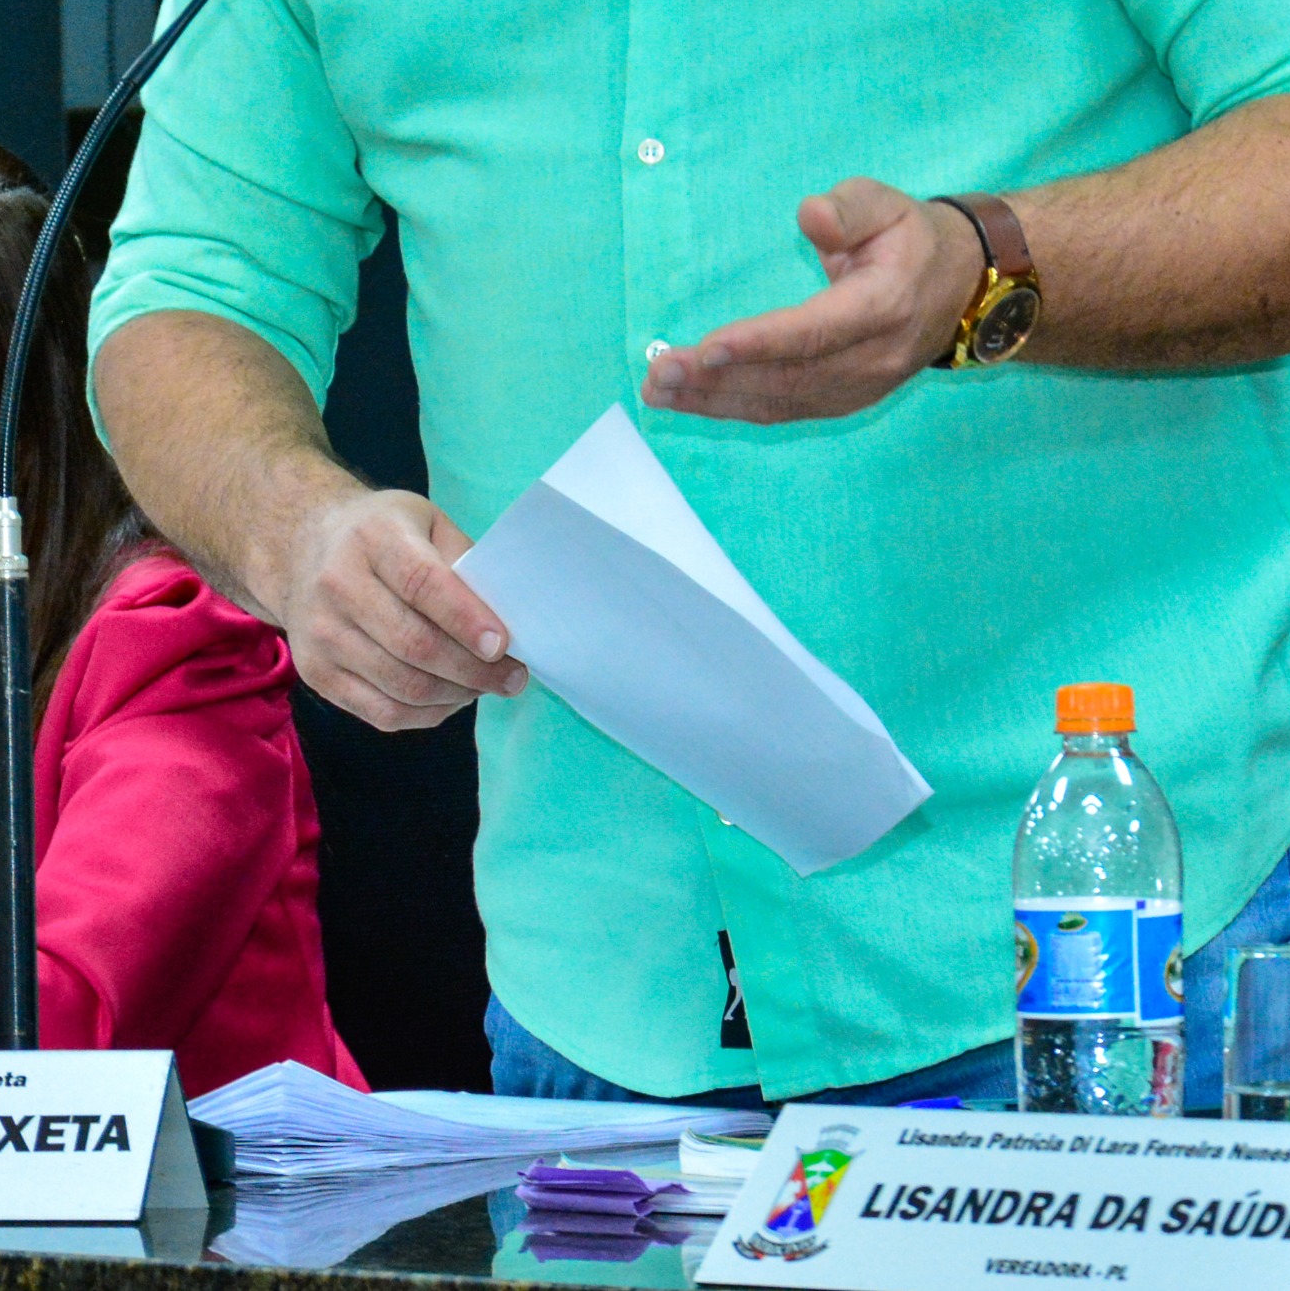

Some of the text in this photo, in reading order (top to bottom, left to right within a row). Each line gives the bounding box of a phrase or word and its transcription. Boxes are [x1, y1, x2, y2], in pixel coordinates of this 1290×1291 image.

[897, 1128, 984, 1148] Lisandra
[1068, 1135, 1093, 1153] Di
[1094, 1137, 1140, 1155] Lara
[1144, 1139, 1224, 1159] Ferreira
[859, 1183, 1081, 1229] LISANDRA
[1088, 1194, 1152, 1233] DA
[985, 1258, 1093, 1279] VEREADORA
[1104, 1264, 1128, 1281] PL
